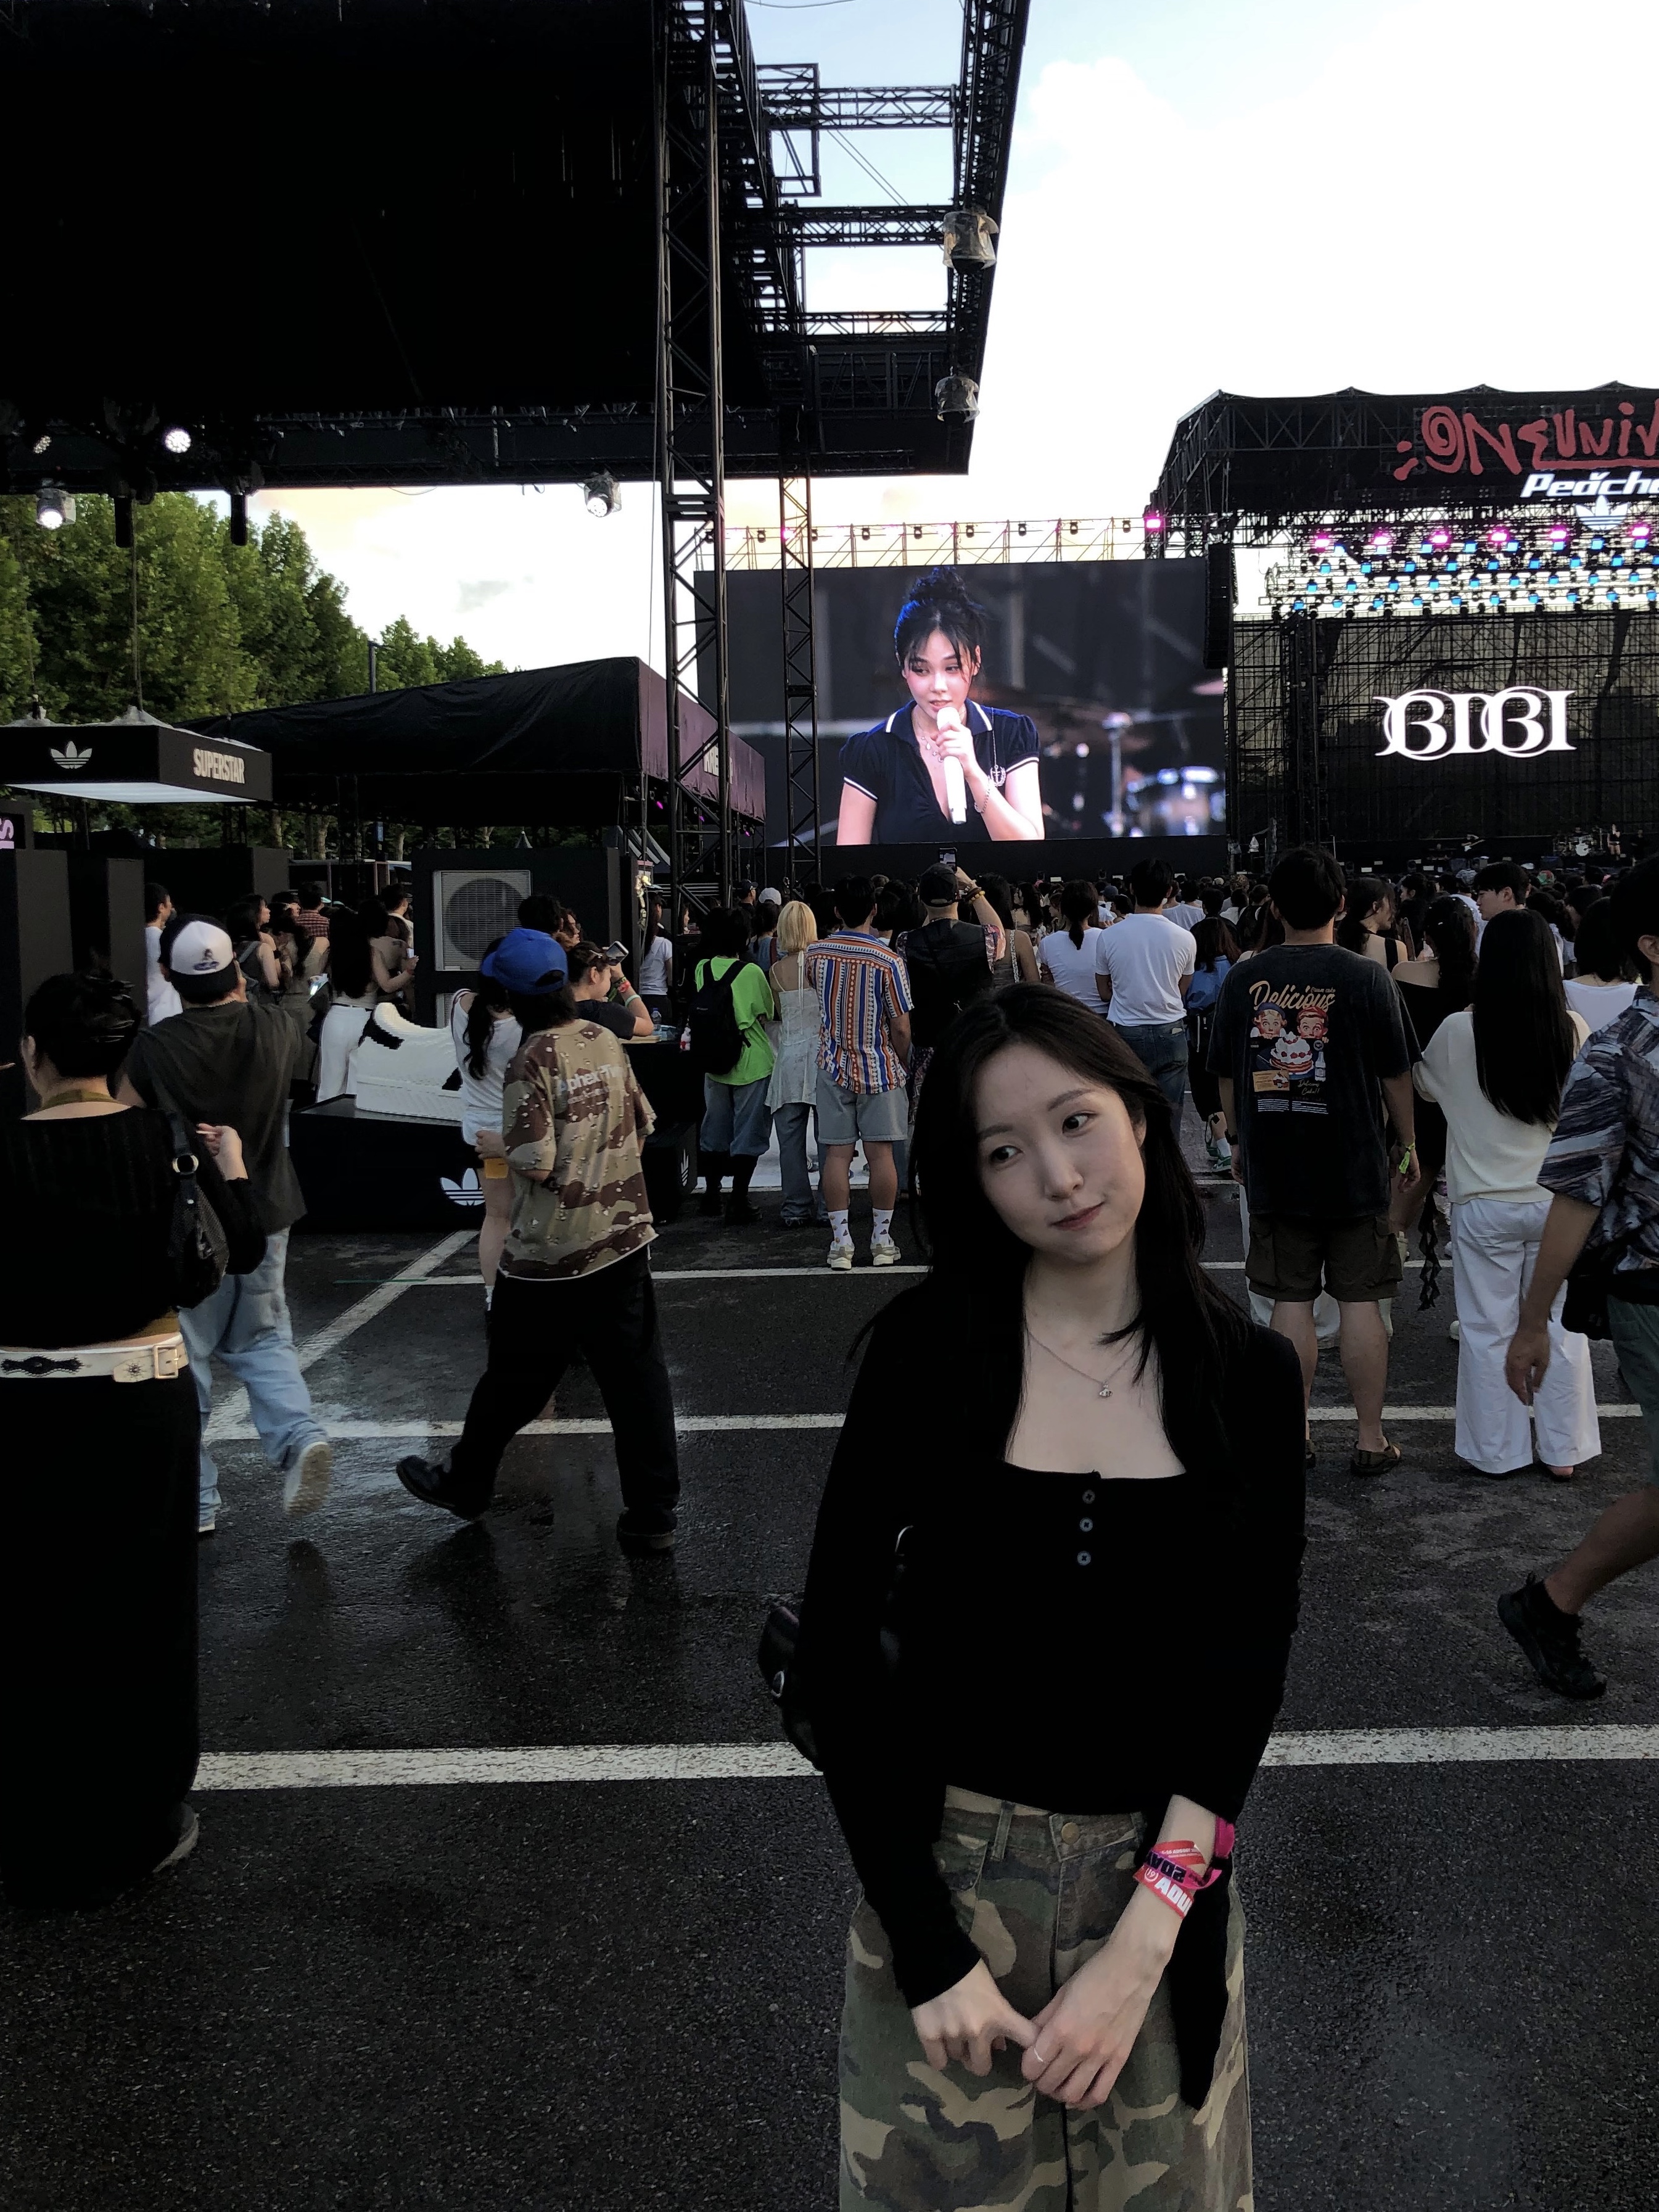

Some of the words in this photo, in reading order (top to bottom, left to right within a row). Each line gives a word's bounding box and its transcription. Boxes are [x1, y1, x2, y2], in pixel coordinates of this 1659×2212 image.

[1372, 686, 1577, 761] BIBI
[193, 748, 245, 784] SUPERSTAR
[1249, 980, 1336, 1012] Delicious
